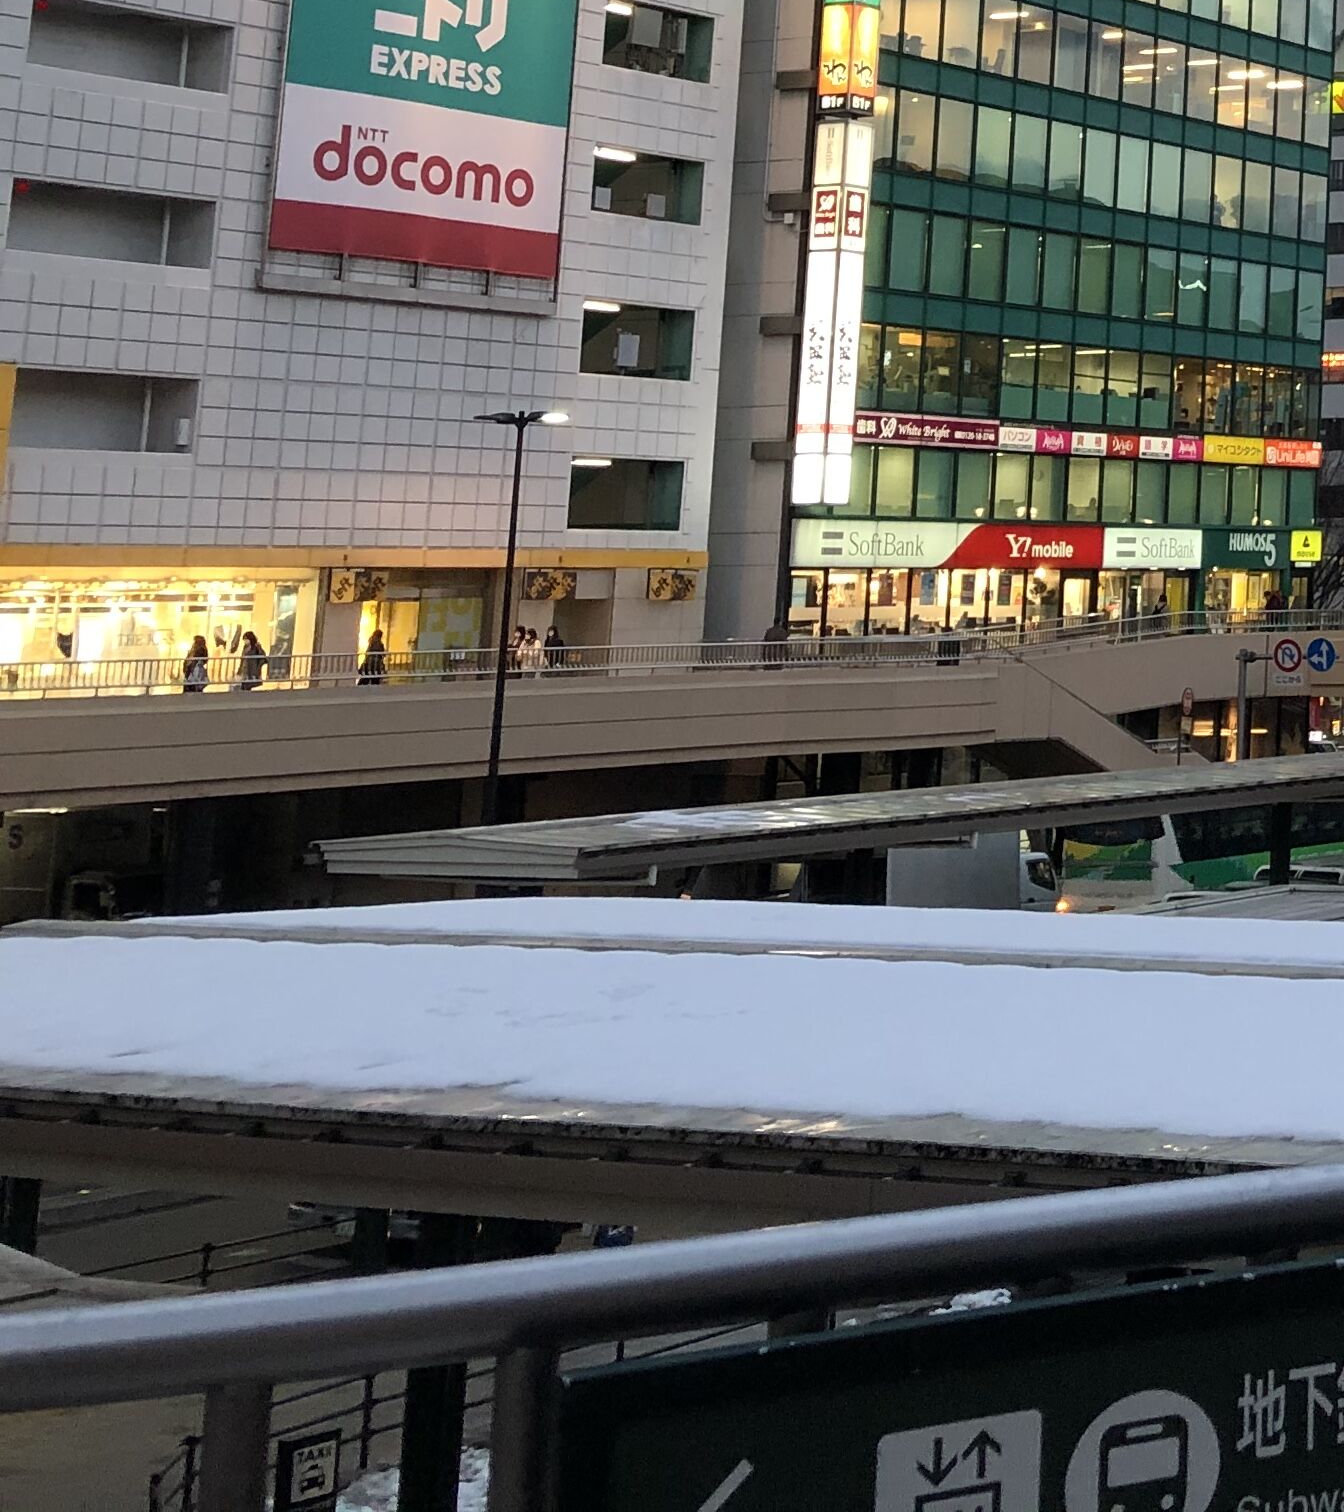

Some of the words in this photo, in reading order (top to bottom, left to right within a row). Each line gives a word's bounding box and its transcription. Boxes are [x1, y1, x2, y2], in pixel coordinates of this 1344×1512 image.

[369, 44, 502, 96] EXPRESS
[357, 125, 389, 143] NTT
[313, 124, 535, 208] docomo
[857, 419, 876, 435] 歯科
[898, 422, 922, 437] White
[923, 425, 950, 441] Bright
[848, 531, 924, 557] SoftBank
[1141, 536, 1195, 559] SoftBank
